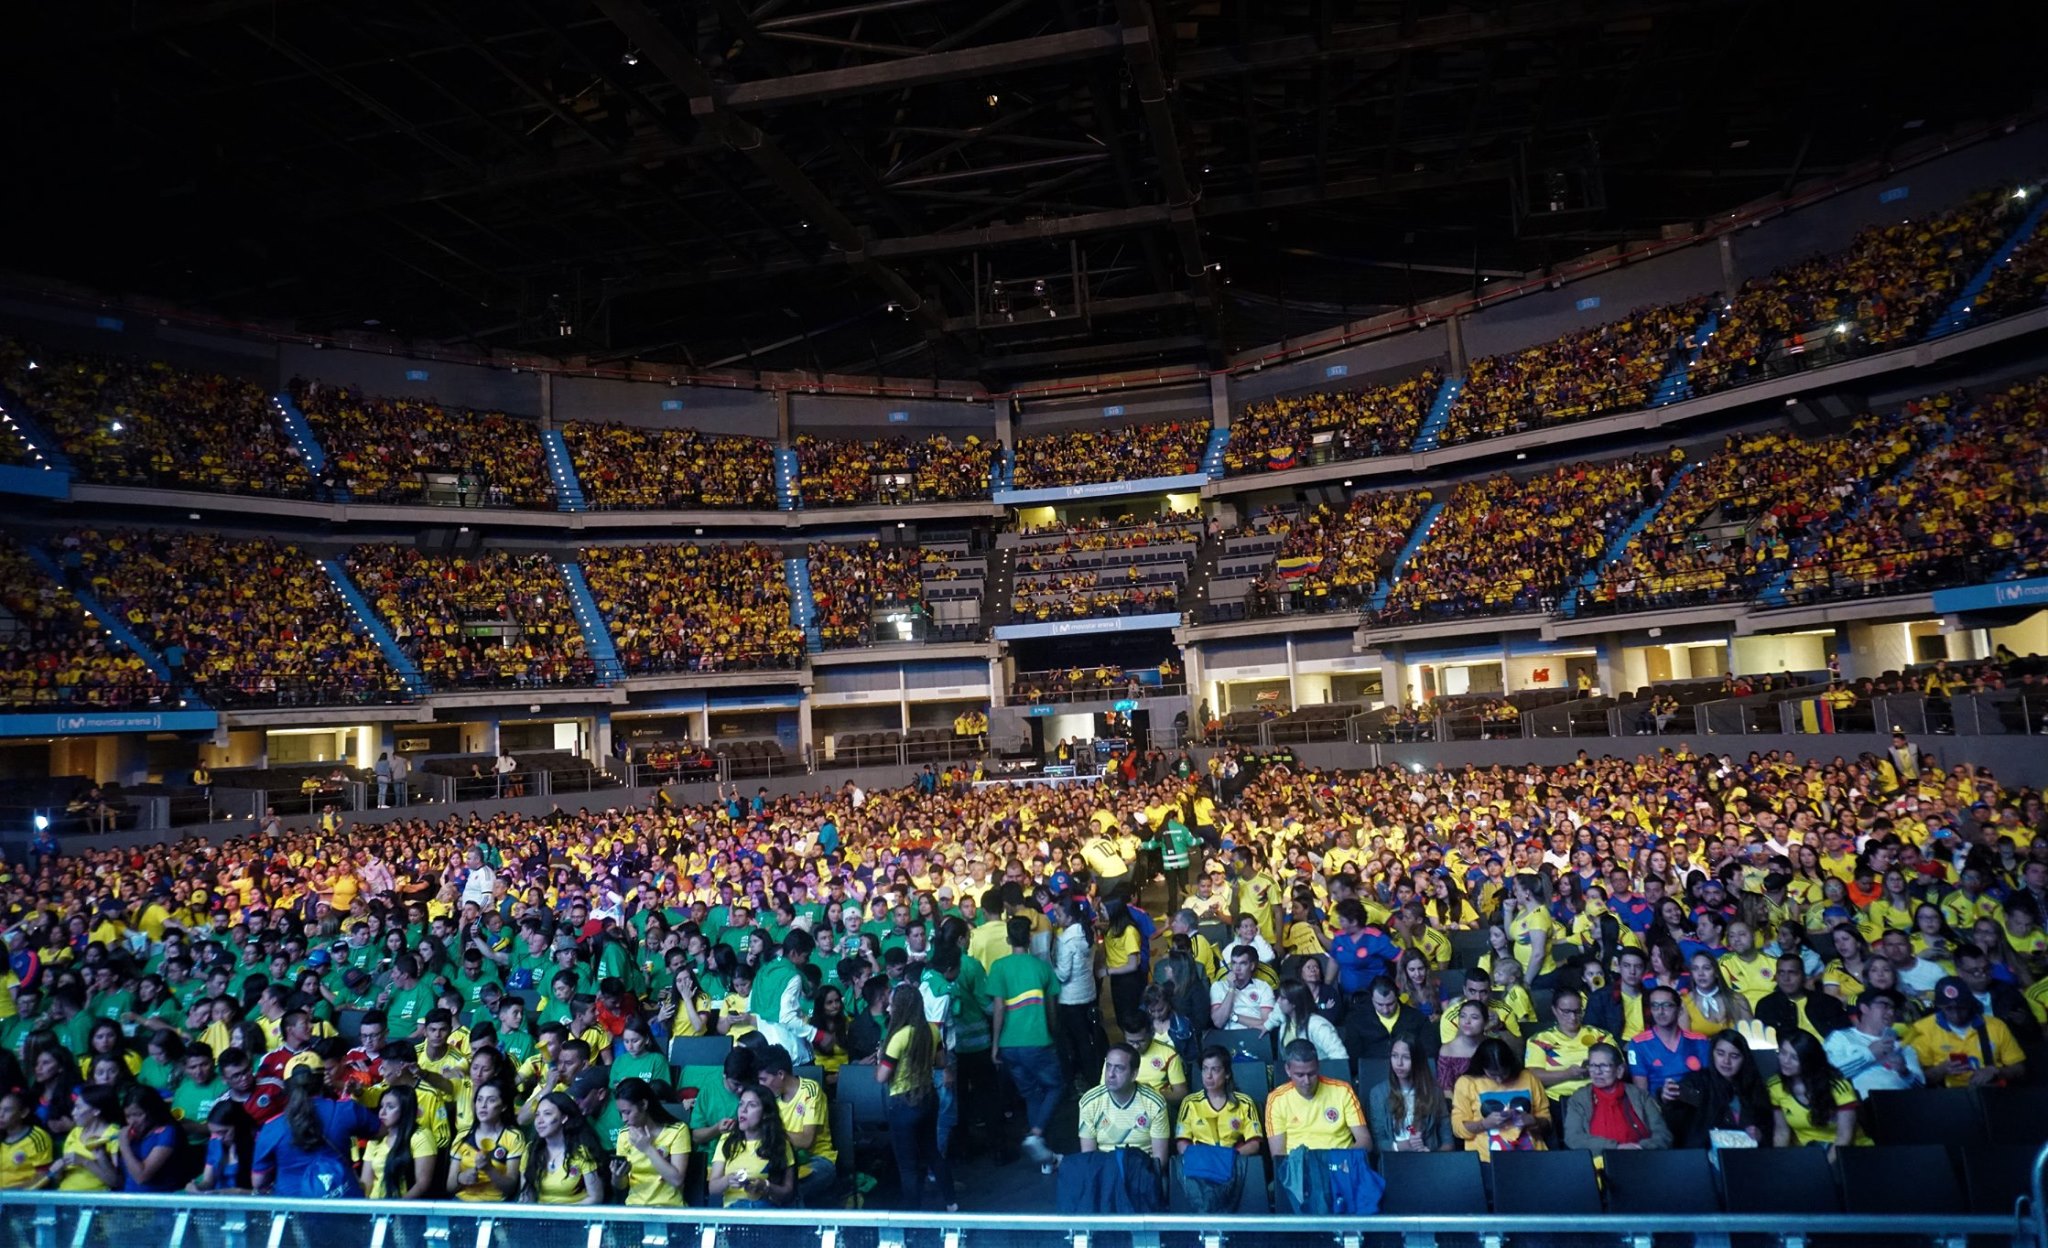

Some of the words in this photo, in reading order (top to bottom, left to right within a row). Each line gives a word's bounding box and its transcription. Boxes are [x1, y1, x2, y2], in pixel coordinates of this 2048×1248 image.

[1085, 485, 1109, 493] movistar
[86, 719, 125, 727] movistar
[126, 718, 152, 726] arena
[1093, 841, 1116, 858] 10
